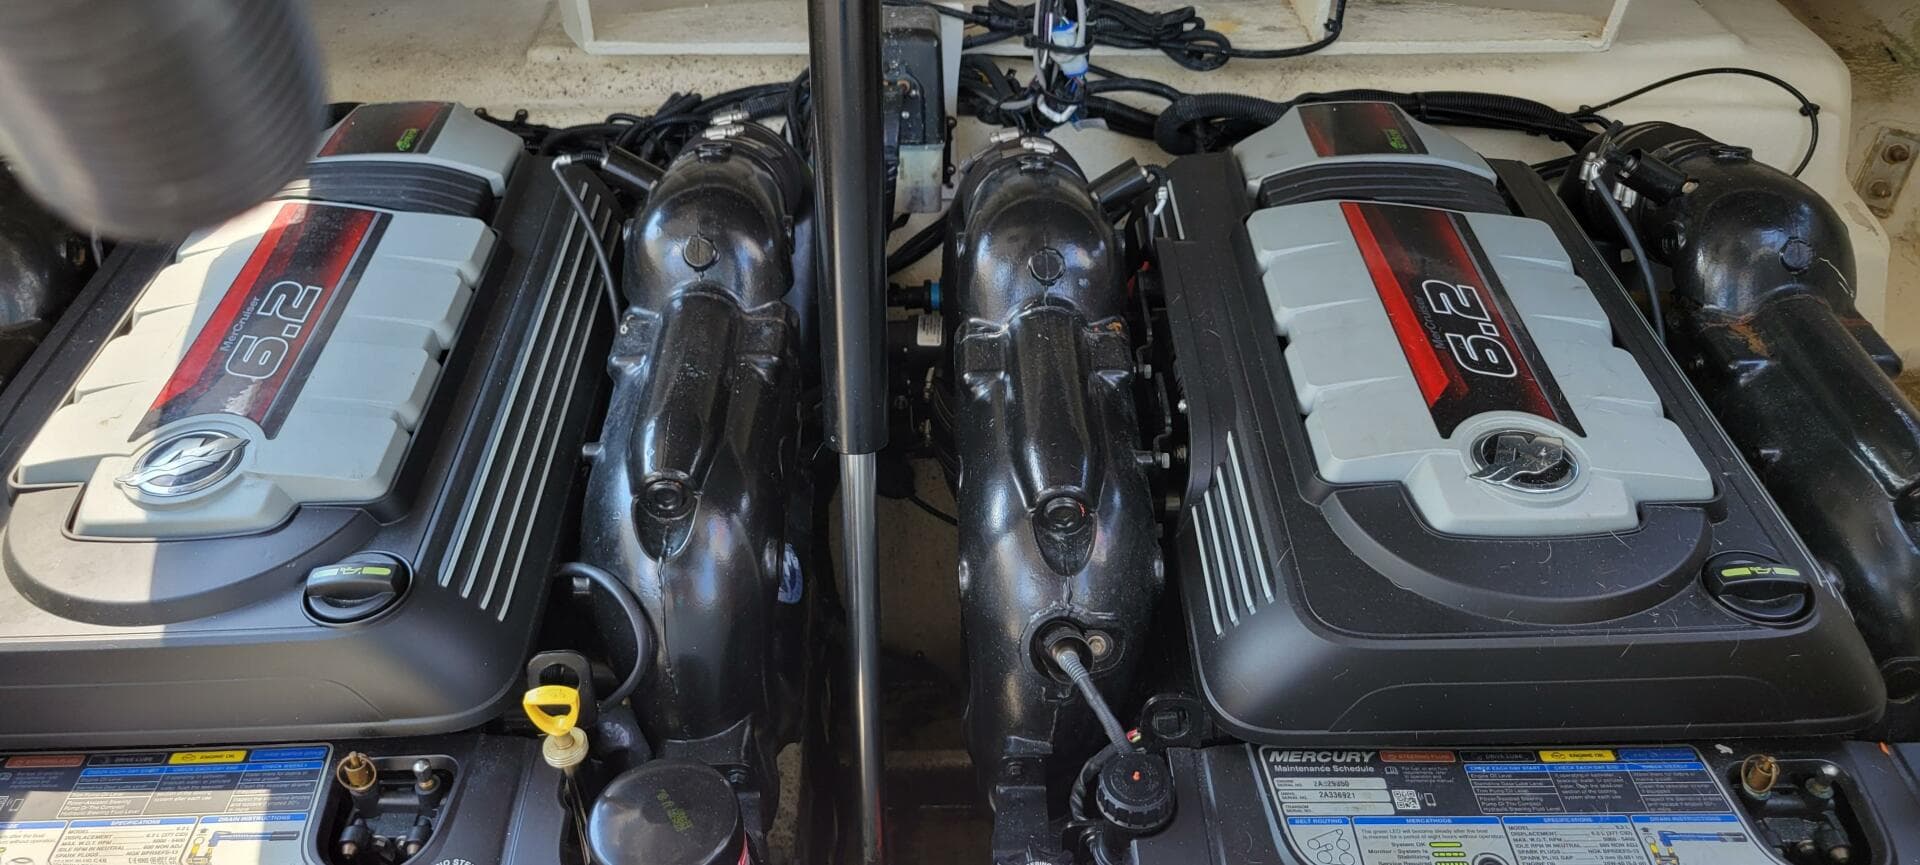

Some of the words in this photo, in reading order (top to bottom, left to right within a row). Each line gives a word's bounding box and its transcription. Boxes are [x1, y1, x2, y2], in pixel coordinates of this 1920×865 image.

[220, 296, 260, 352] MerCruiser
[225, 281, 322, 380] 6.2
[1422, 280, 1517, 378] 6.2
[1269, 751, 1376, 763] MERCURY
[1274, 765, 1331, 773] Maintenance
[1332, 765, 1375, 773] Schedule
